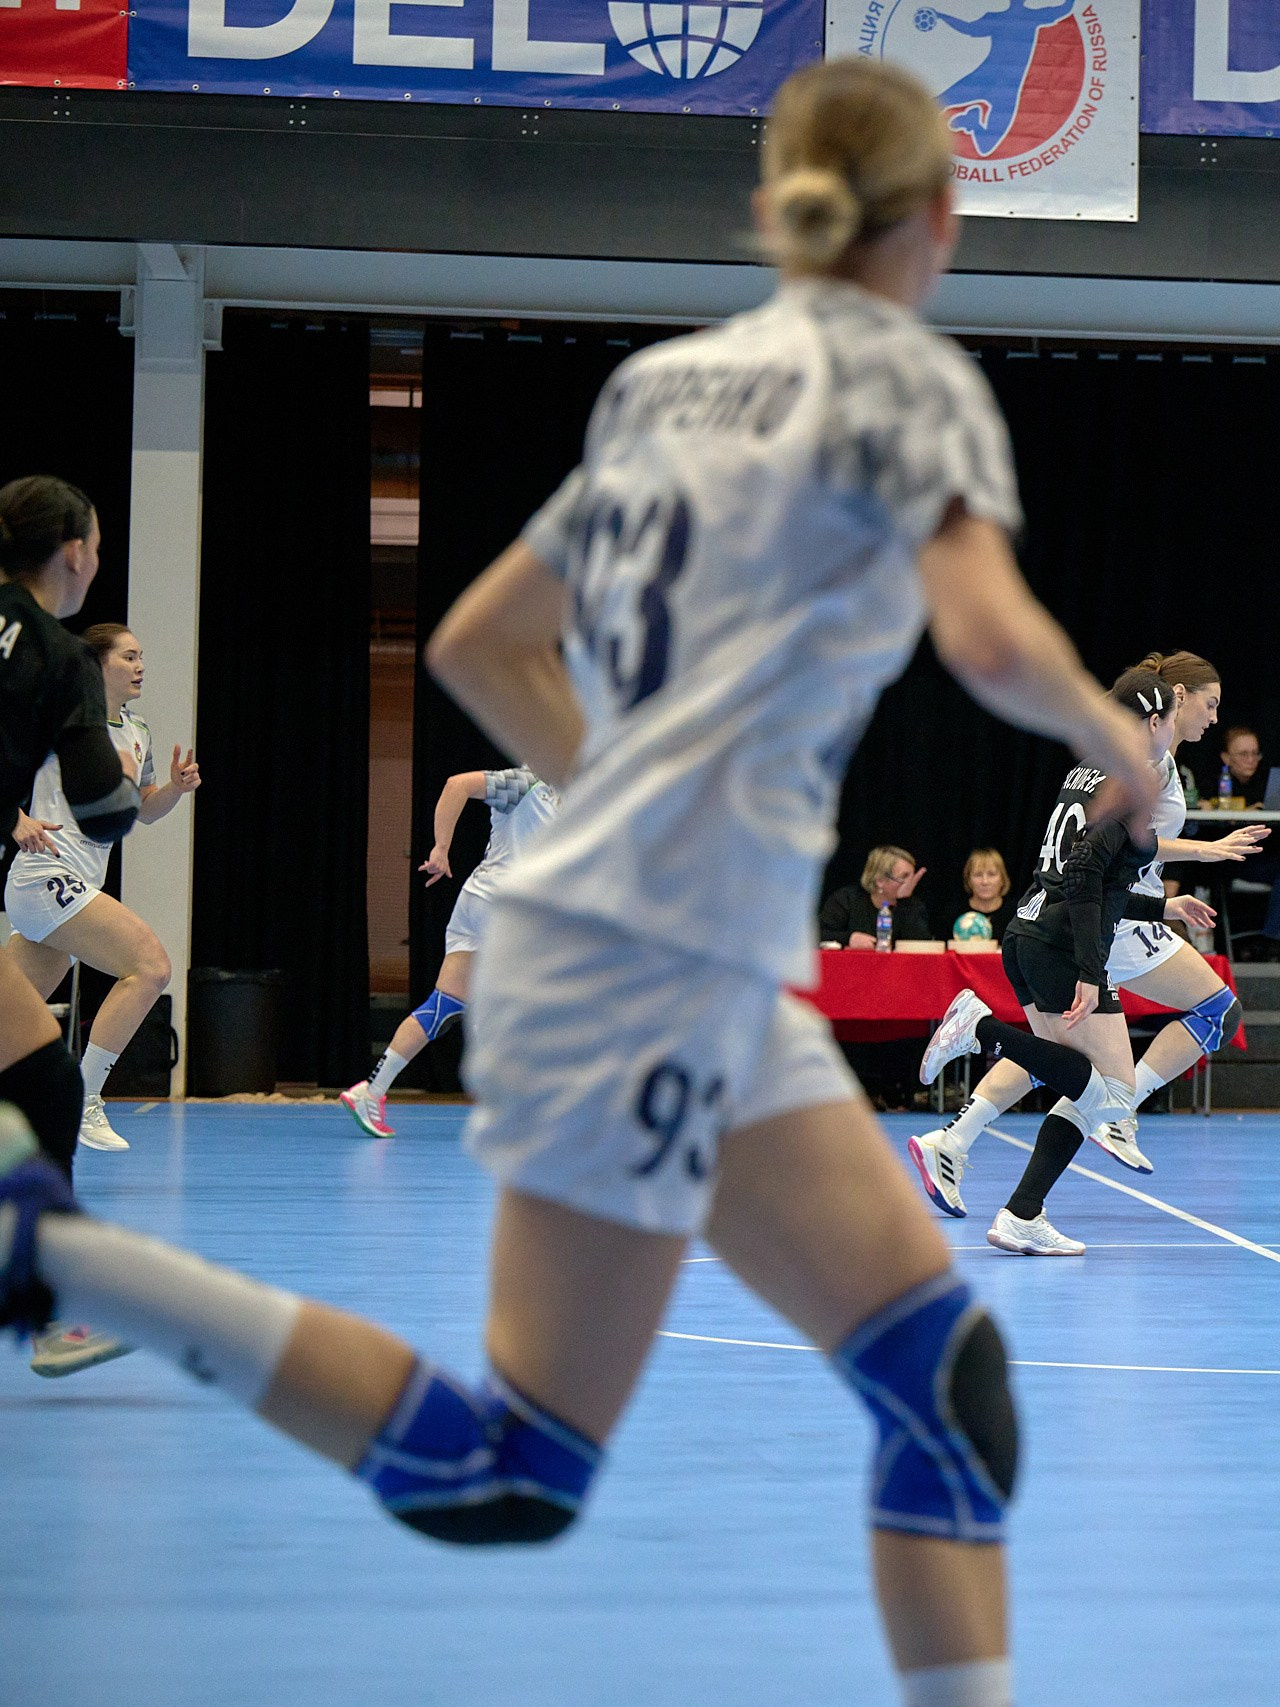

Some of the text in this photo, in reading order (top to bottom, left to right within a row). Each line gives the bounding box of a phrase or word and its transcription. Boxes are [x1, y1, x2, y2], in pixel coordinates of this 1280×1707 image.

[1082, 4, 1107, 74] RUSSIA
[1088, 76, 1106, 101] OF
[1008, 103, 1098, 180] FEDERATION
[1039, 803, 1087, 875] 40
[1132, 921, 1174, 958] 14
